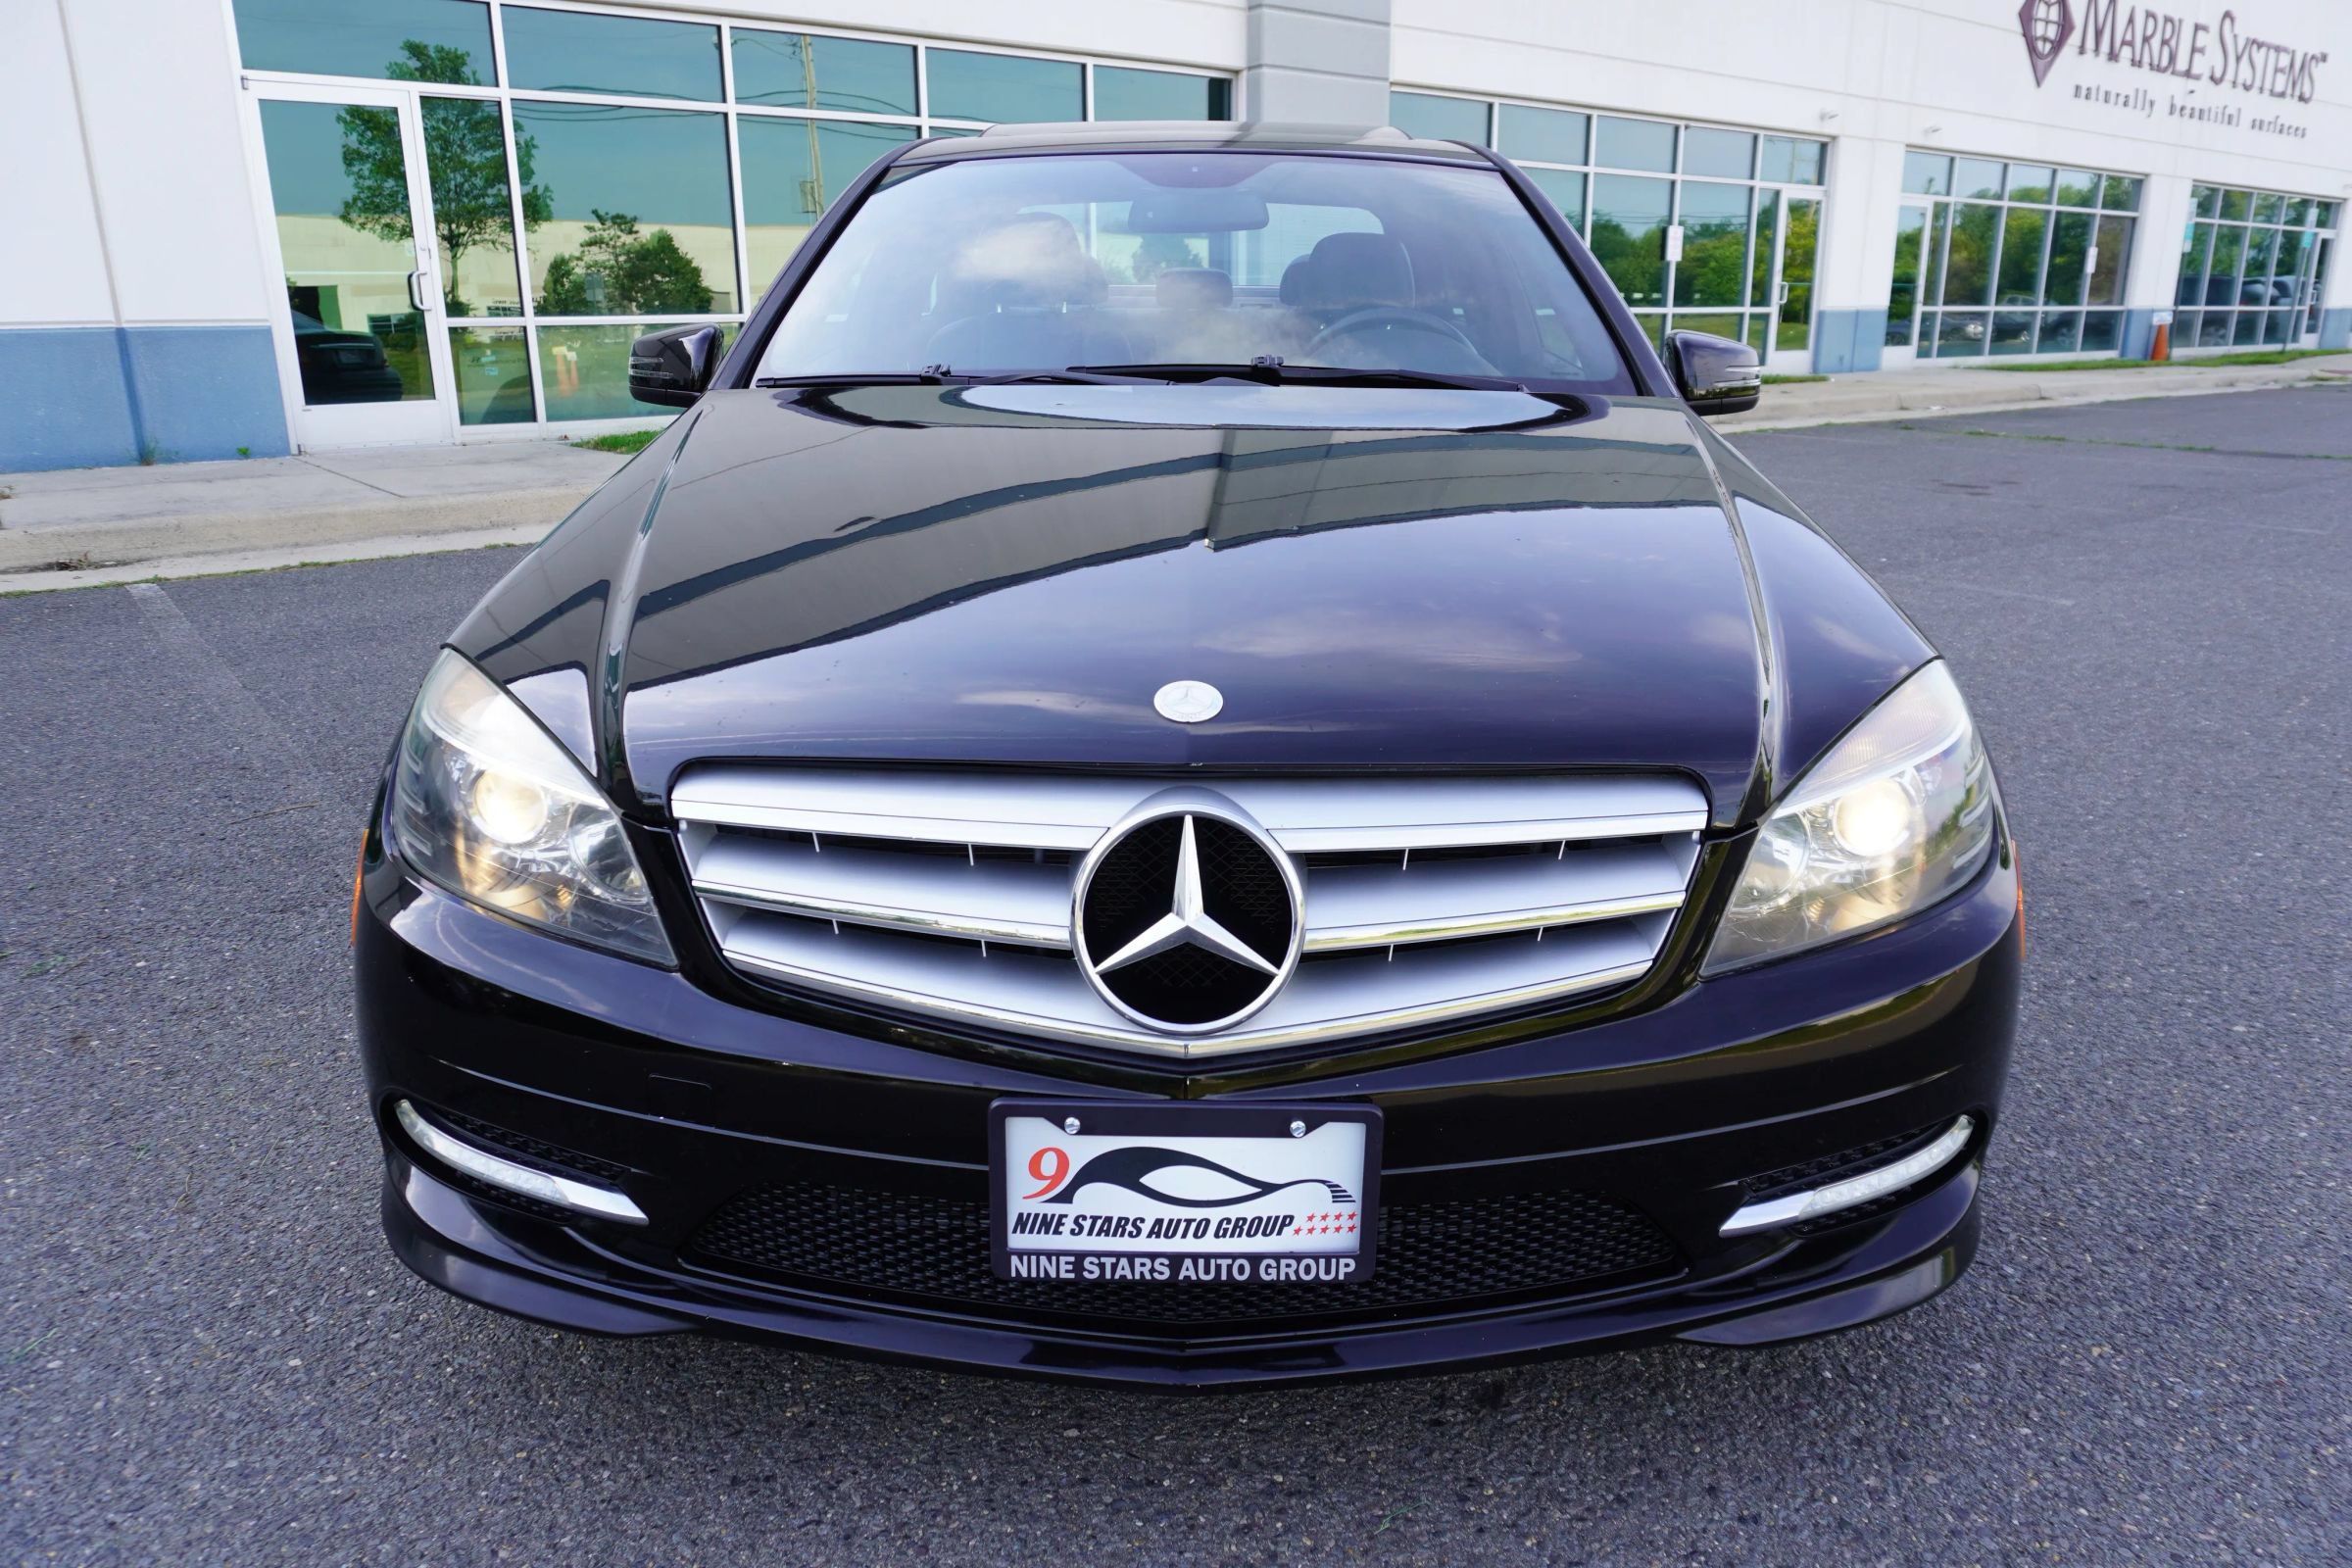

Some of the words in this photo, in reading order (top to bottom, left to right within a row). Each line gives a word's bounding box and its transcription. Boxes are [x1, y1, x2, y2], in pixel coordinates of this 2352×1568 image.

[2078, 0, 2210, 80] MARBLE
[2074, 83, 2156, 118] naturally
[2169, 95, 2242, 128] beautiful
[2250, 115, 2308, 139] surfaces
[1022, 1147, 1070, 1200] 9
[1011, 1212, 1068, 1236] NINE
[1069, 1214, 1146, 1239] STARS
[1146, 1217, 1211, 1240] AUTO
[1213, 1214, 1296, 1240] GROUP
[1010, 1254, 1076, 1279] NINE
[1083, 1256, 1171, 1281] STARS
[1178, 1257, 1251, 1281] AUTO
[1259, 1257, 1357, 1281] GROUP
